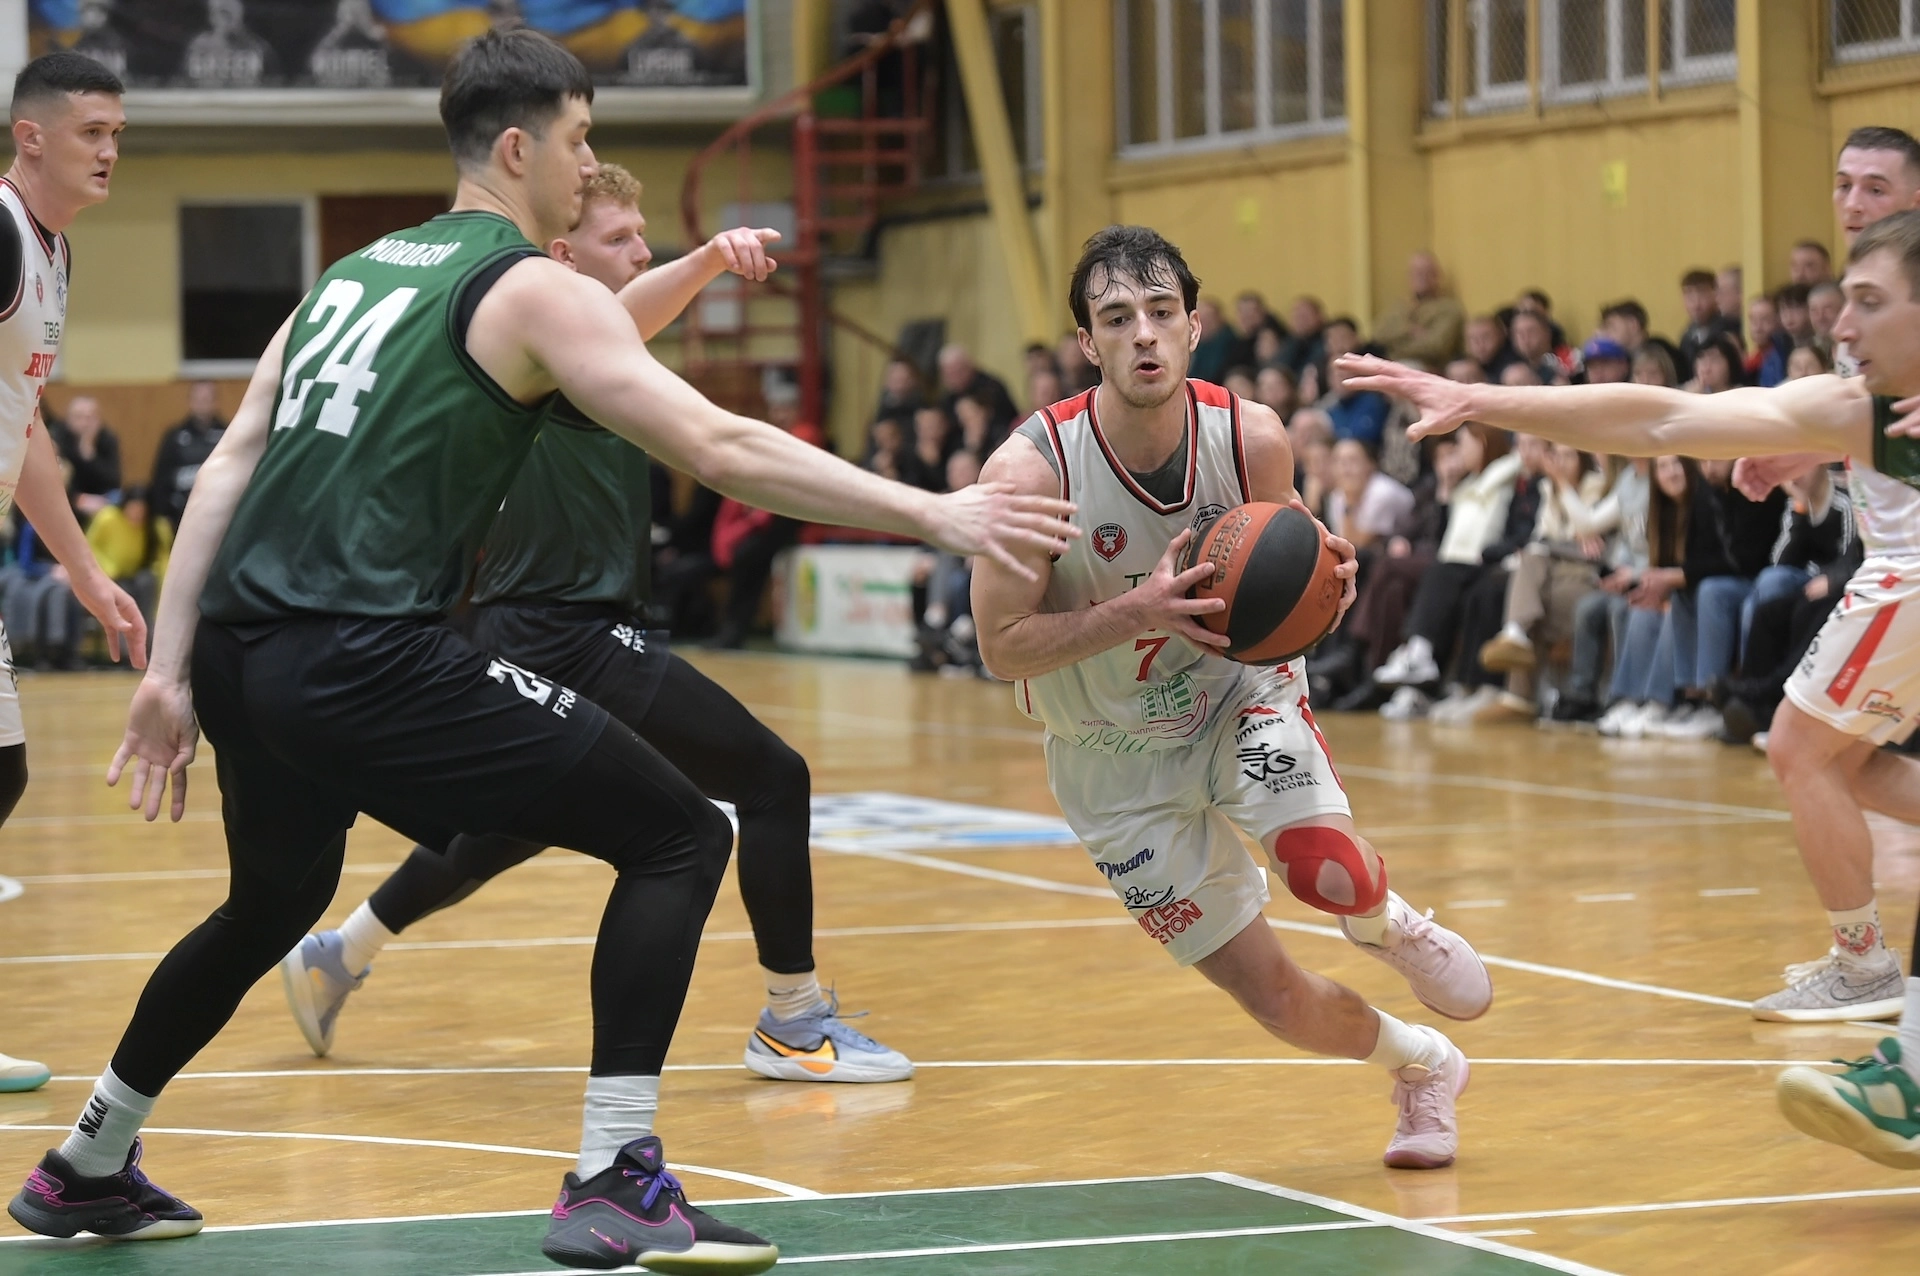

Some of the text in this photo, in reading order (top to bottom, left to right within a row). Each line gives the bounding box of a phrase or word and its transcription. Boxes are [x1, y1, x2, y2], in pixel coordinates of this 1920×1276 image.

[360, 238, 462, 267] MOROZOV
[44, 321, 60, 339] TBG
[274, 279, 419, 437] 24
[1134, 636, 1170, 682] 7
[1265, 771, 1312, 789] VECTOR
[1272, 779, 1321, 794] GLOBAL
[1096, 848, 1154, 880] Dream
